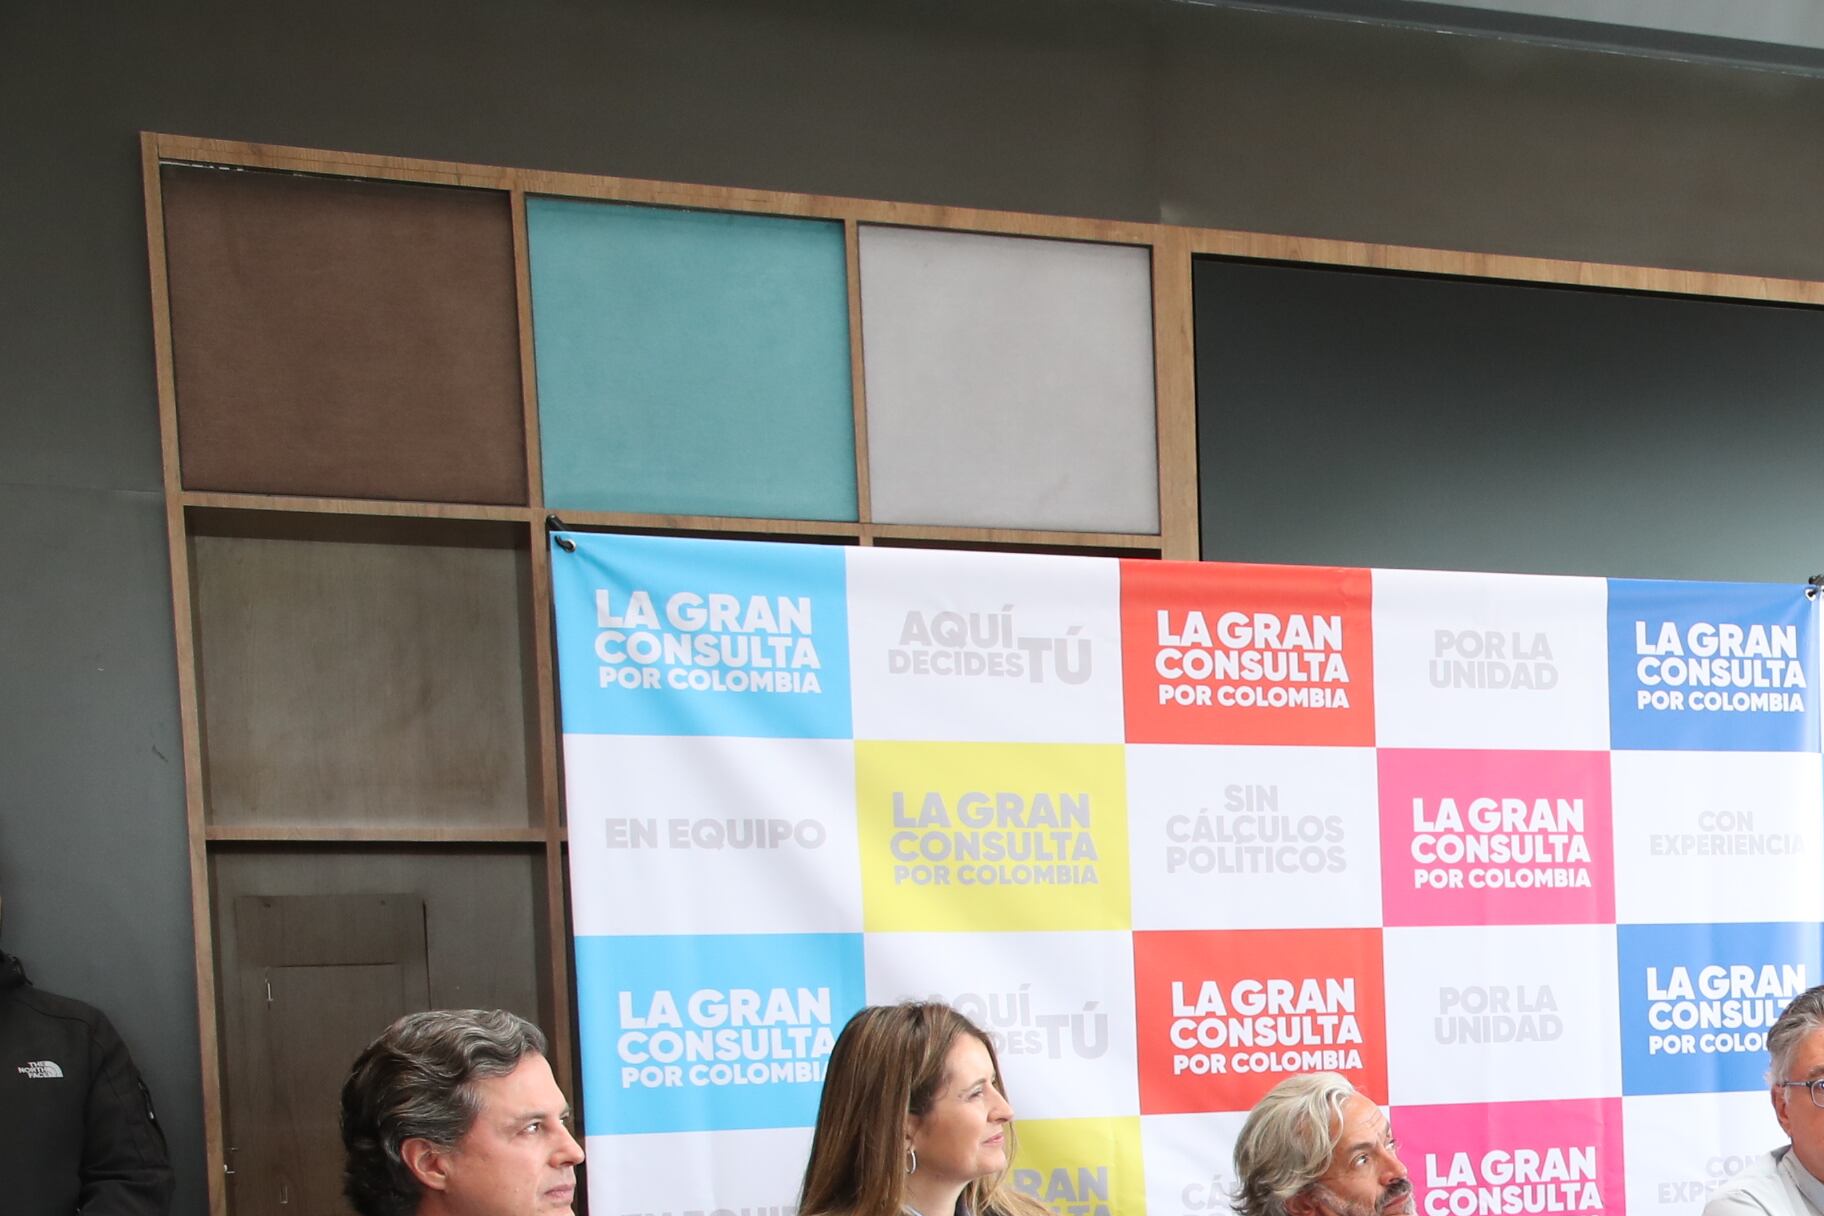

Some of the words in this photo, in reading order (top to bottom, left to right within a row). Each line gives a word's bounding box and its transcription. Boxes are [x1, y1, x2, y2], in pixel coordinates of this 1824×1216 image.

[595, 589, 660, 629] LA
[666, 592, 812, 634] GRAN
[899, 605, 1013, 649] AQUÍ
[1156, 610, 1212, 648] LA
[1217, 612, 1343, 651] GRAN
[1434, 629, 1506, 659] POR
[1512, 632, 1553, 661] LA
[1635, 621, 1683, 657] LA
[1687, 624, 1797, 659] GRAN
[594, 631, 821, 670] CONSULTA
[888, 649, 1024, 678] DECIDES
[1017, 626, 1092, 685] TÚ
[1155, 648, 1350, 683] CONSULTA
[599, 667, 661, 690] POR
[667, 668, 822, 694] COLOMBIA
[1429, 660, 1559, 691] UNIDAD
[1637, 657, 1806, 688] CONSULTA
[1159, 685, 1212, 706] POR
[1217, 685, 1350, 709] COLOMBIA
[1637, 690, 1685, 711] POR
[1688, 691, 1805, 713] COLOMBIA
[892, 791, 951, 828] LA
[957, 792, 1091, 829] GRAN
[1224, 785, 1278, 813] SIN
[1165, 809, 1344, 844] CÁLCULOS
[1412, 798, 1464, 833] LA
[1468, 798, 1584, 834] GRAN
[1698, 810, 1754, 833] CON
[605, 818, 661, 849] EN
[667, 818, 826, 851] EQUIPO
[890, 830, 1098, 863] CONSULTA
[1411, 834, 1592, 864] CONSULTA
[1649, 833, 1805, 857] EXPERIENCIA
[1166, 838, 1346, 875] POLÍTICOS
[894, 865, 952, 885] POR
[957, 865, 1099, 886] COLOMBIA
[1415, 869, 1464, 889] POR
[1469, 869, 1592, 889] COLOMBIA
[1171, 980, 1227, 1018] LA
[1231, 978, 1356, 1016] GRAN
[1647, 966, 1695, 1001] LA
[1699, 964, 1806, 999] GRAN
[617, 989, 681, 1029] LA
[687, 987, 832, 1027] GRAN
[1439, 986, 1510, 1016] POR
[1518, 985, 1558, 1012] LA
[616, 1027, 834, 1064] CONSULTA
[1034, 1001, 1109, 1060] TÚ
[1170, 1015, 1363, 1049] CONSULTA
[1435, 1014, 1564, 1045] UNIDAD
[1649, 1034, 1697, 1056] POR
[622, 1064, 683, 1089] POR
[1173, 1054, 1227, 1076] POR
[1232, 1050, 1363, 1073] COLOMBIA
[1425, 1152, 1477, 1188] LA
[1481, 1146, 1597, 1184] GRAN
